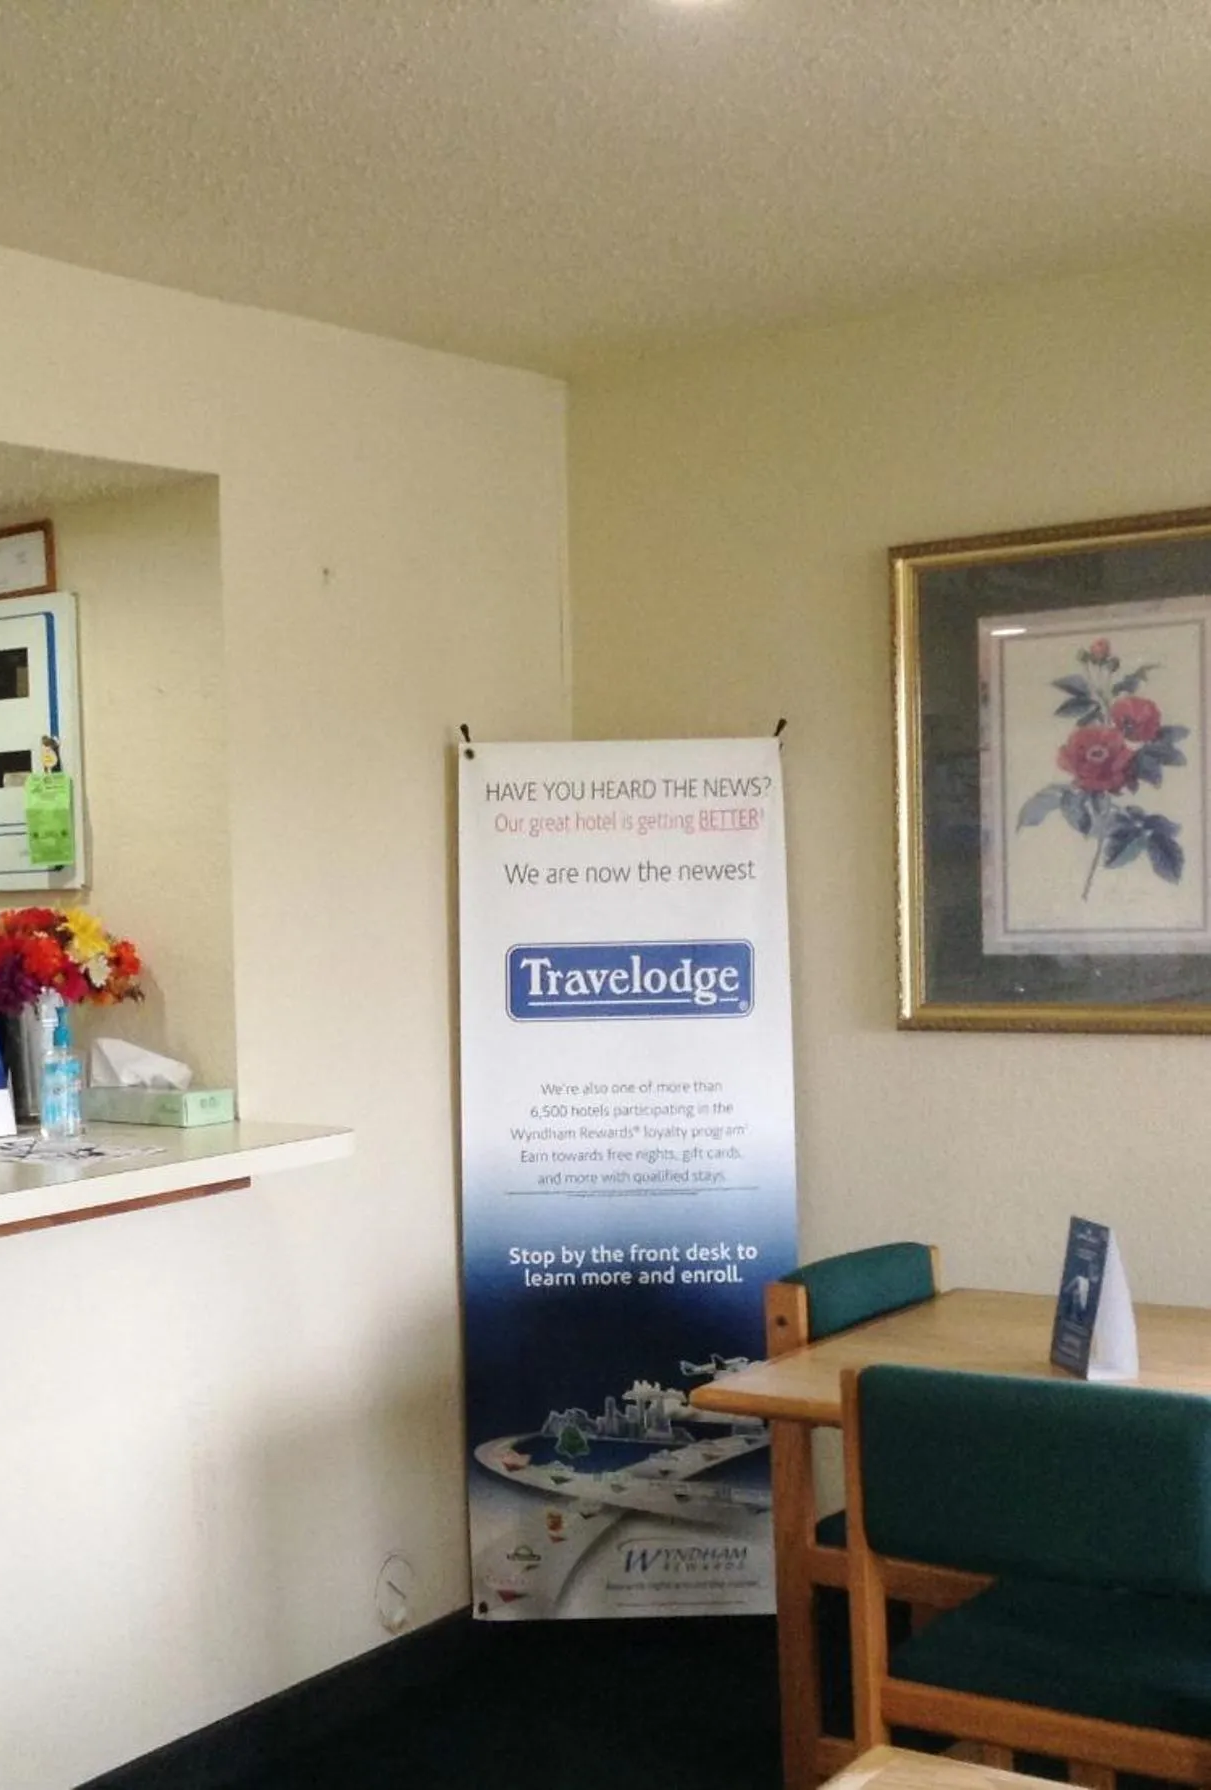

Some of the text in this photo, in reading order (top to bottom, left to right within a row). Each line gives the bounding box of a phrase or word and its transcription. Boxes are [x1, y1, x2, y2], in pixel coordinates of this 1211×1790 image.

[486, 776, 772, 801] HAVE YOU HEARD THE NEWS?
[495, 813, 523, 833] Our
[529, 812, 570, 837] great
[575, 811, 617, 832] hotel
[622, 812, 633, 831] is
[637, 811, 694, 835] getting
[505, 860, 756, 886] We are now the newest
[520, 955, 739, 1006] Travelodge
[541, 1080, 722, 1097] We're also one of more than
[530, 1102, 733, 1119] 6,500 hotels participating in the
[510, 1126, 576, 1142] Wyndham
[643, 1124, 688, 1141] loyalty
[520, 1150, 548, 1163] Earn
[552, 1149, 604, 1162] towards
[607, 1148, 633, 1162] free
[682, 1147, 704, 1164] gift
[538, 1171, 561, 1185] and
[565, 1172, 597, 1184] more
[601, 1170, 630, 1183] with
[633, 1169, 689, 1185] qualified
[509, 1243, 757, 1267] Stop by the front desk to
[524, 1264, 743, 1288] learn more and enroll.
